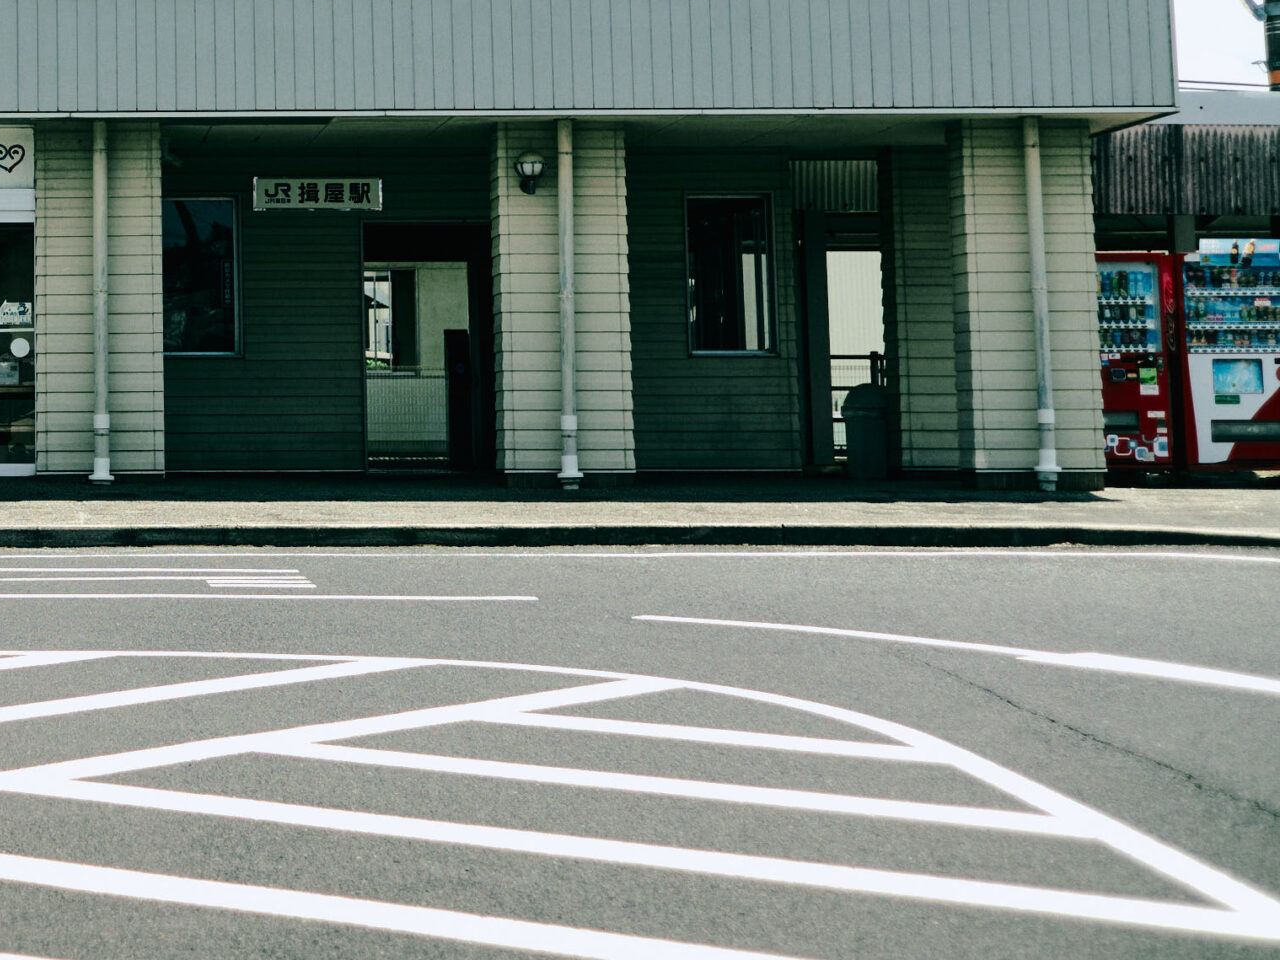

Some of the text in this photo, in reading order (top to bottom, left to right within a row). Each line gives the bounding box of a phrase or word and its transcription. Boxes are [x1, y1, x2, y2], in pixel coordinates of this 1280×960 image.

[264, 182, 371, 204] JR 揖屋駅
